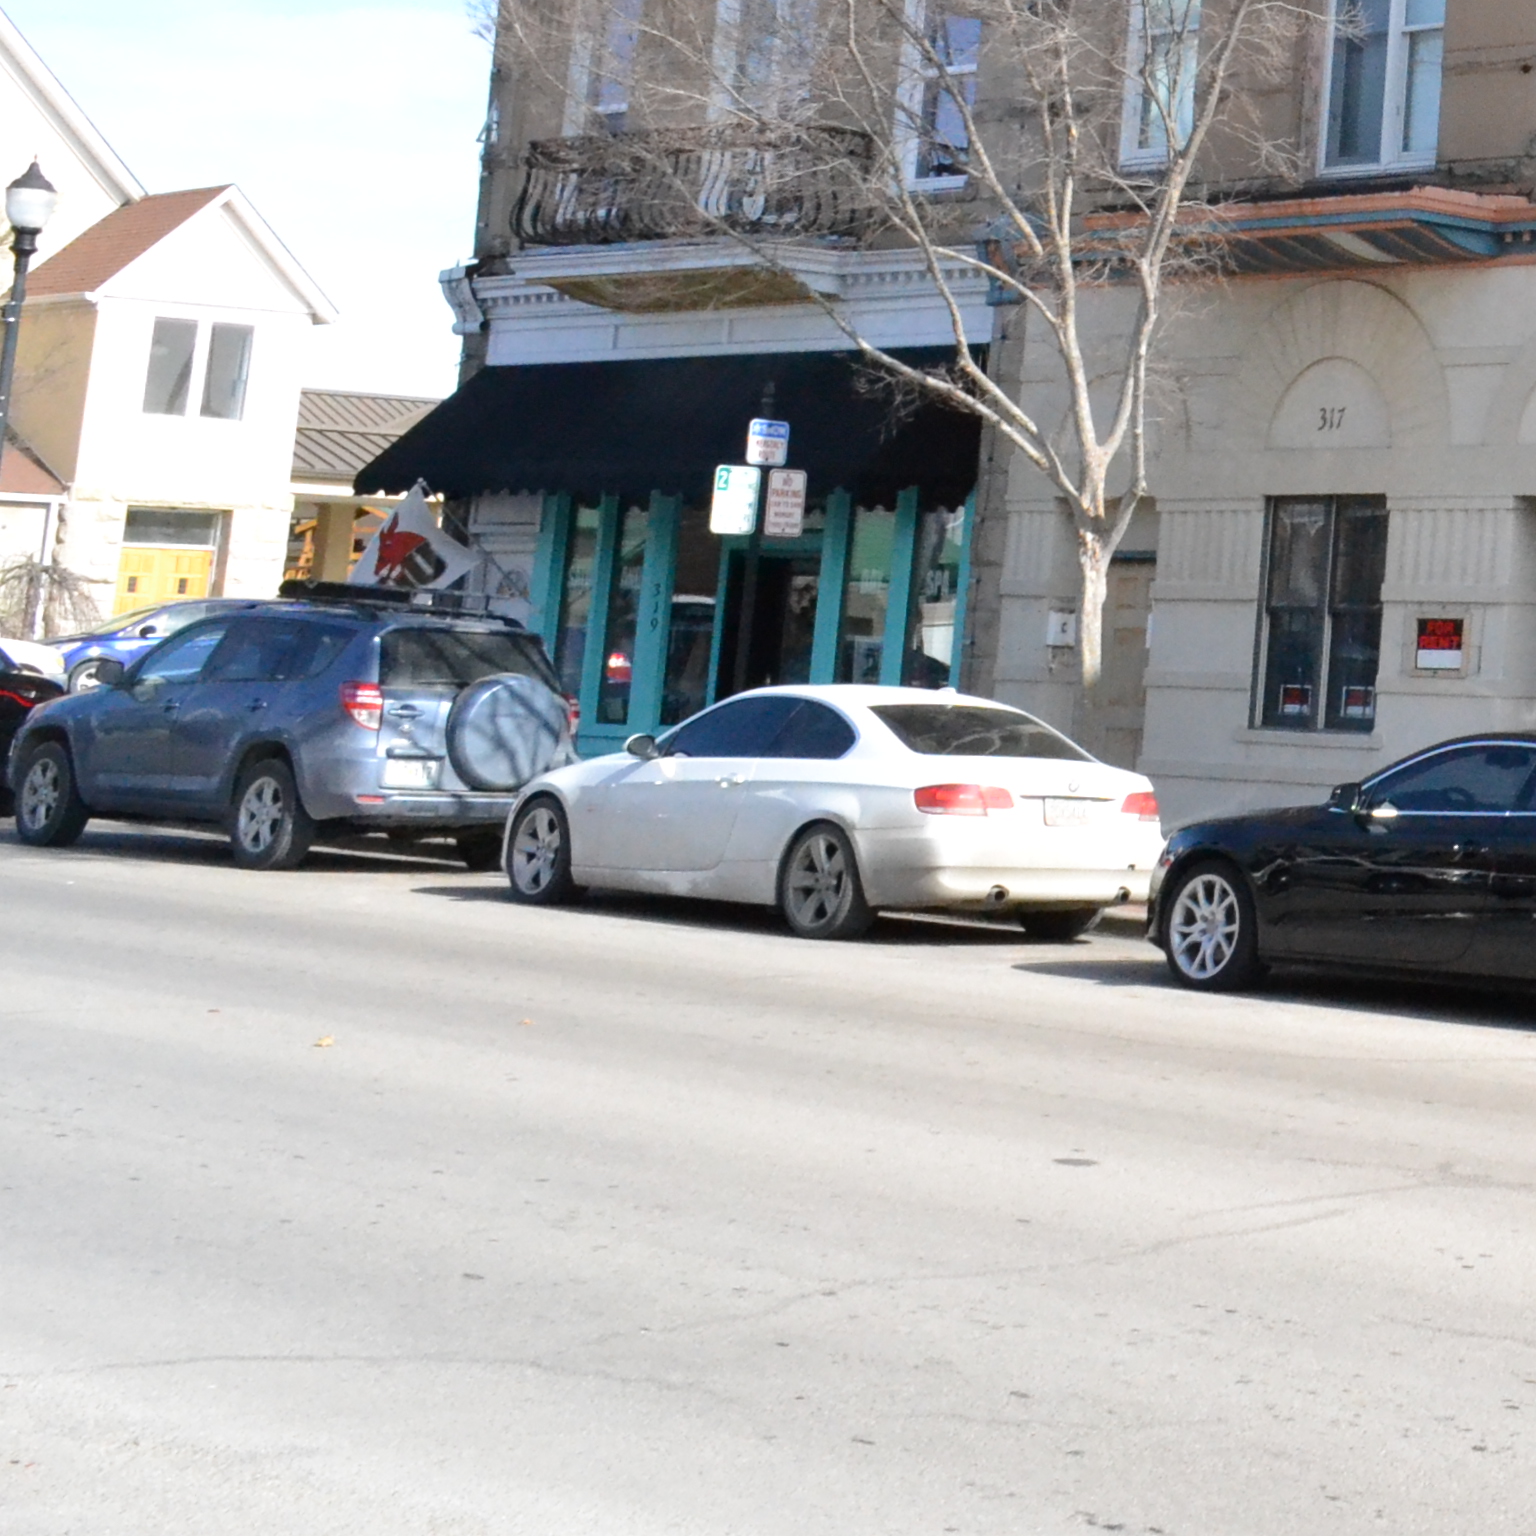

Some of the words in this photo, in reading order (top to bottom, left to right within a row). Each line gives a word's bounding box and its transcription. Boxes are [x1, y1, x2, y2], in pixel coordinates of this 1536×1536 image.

[1317, 406, 1346, 432] 317
[717, 470, 729, 489] 2
[1427, 619, 1455, 635] FOR
[1419, 635, 1460, 649] RENT
